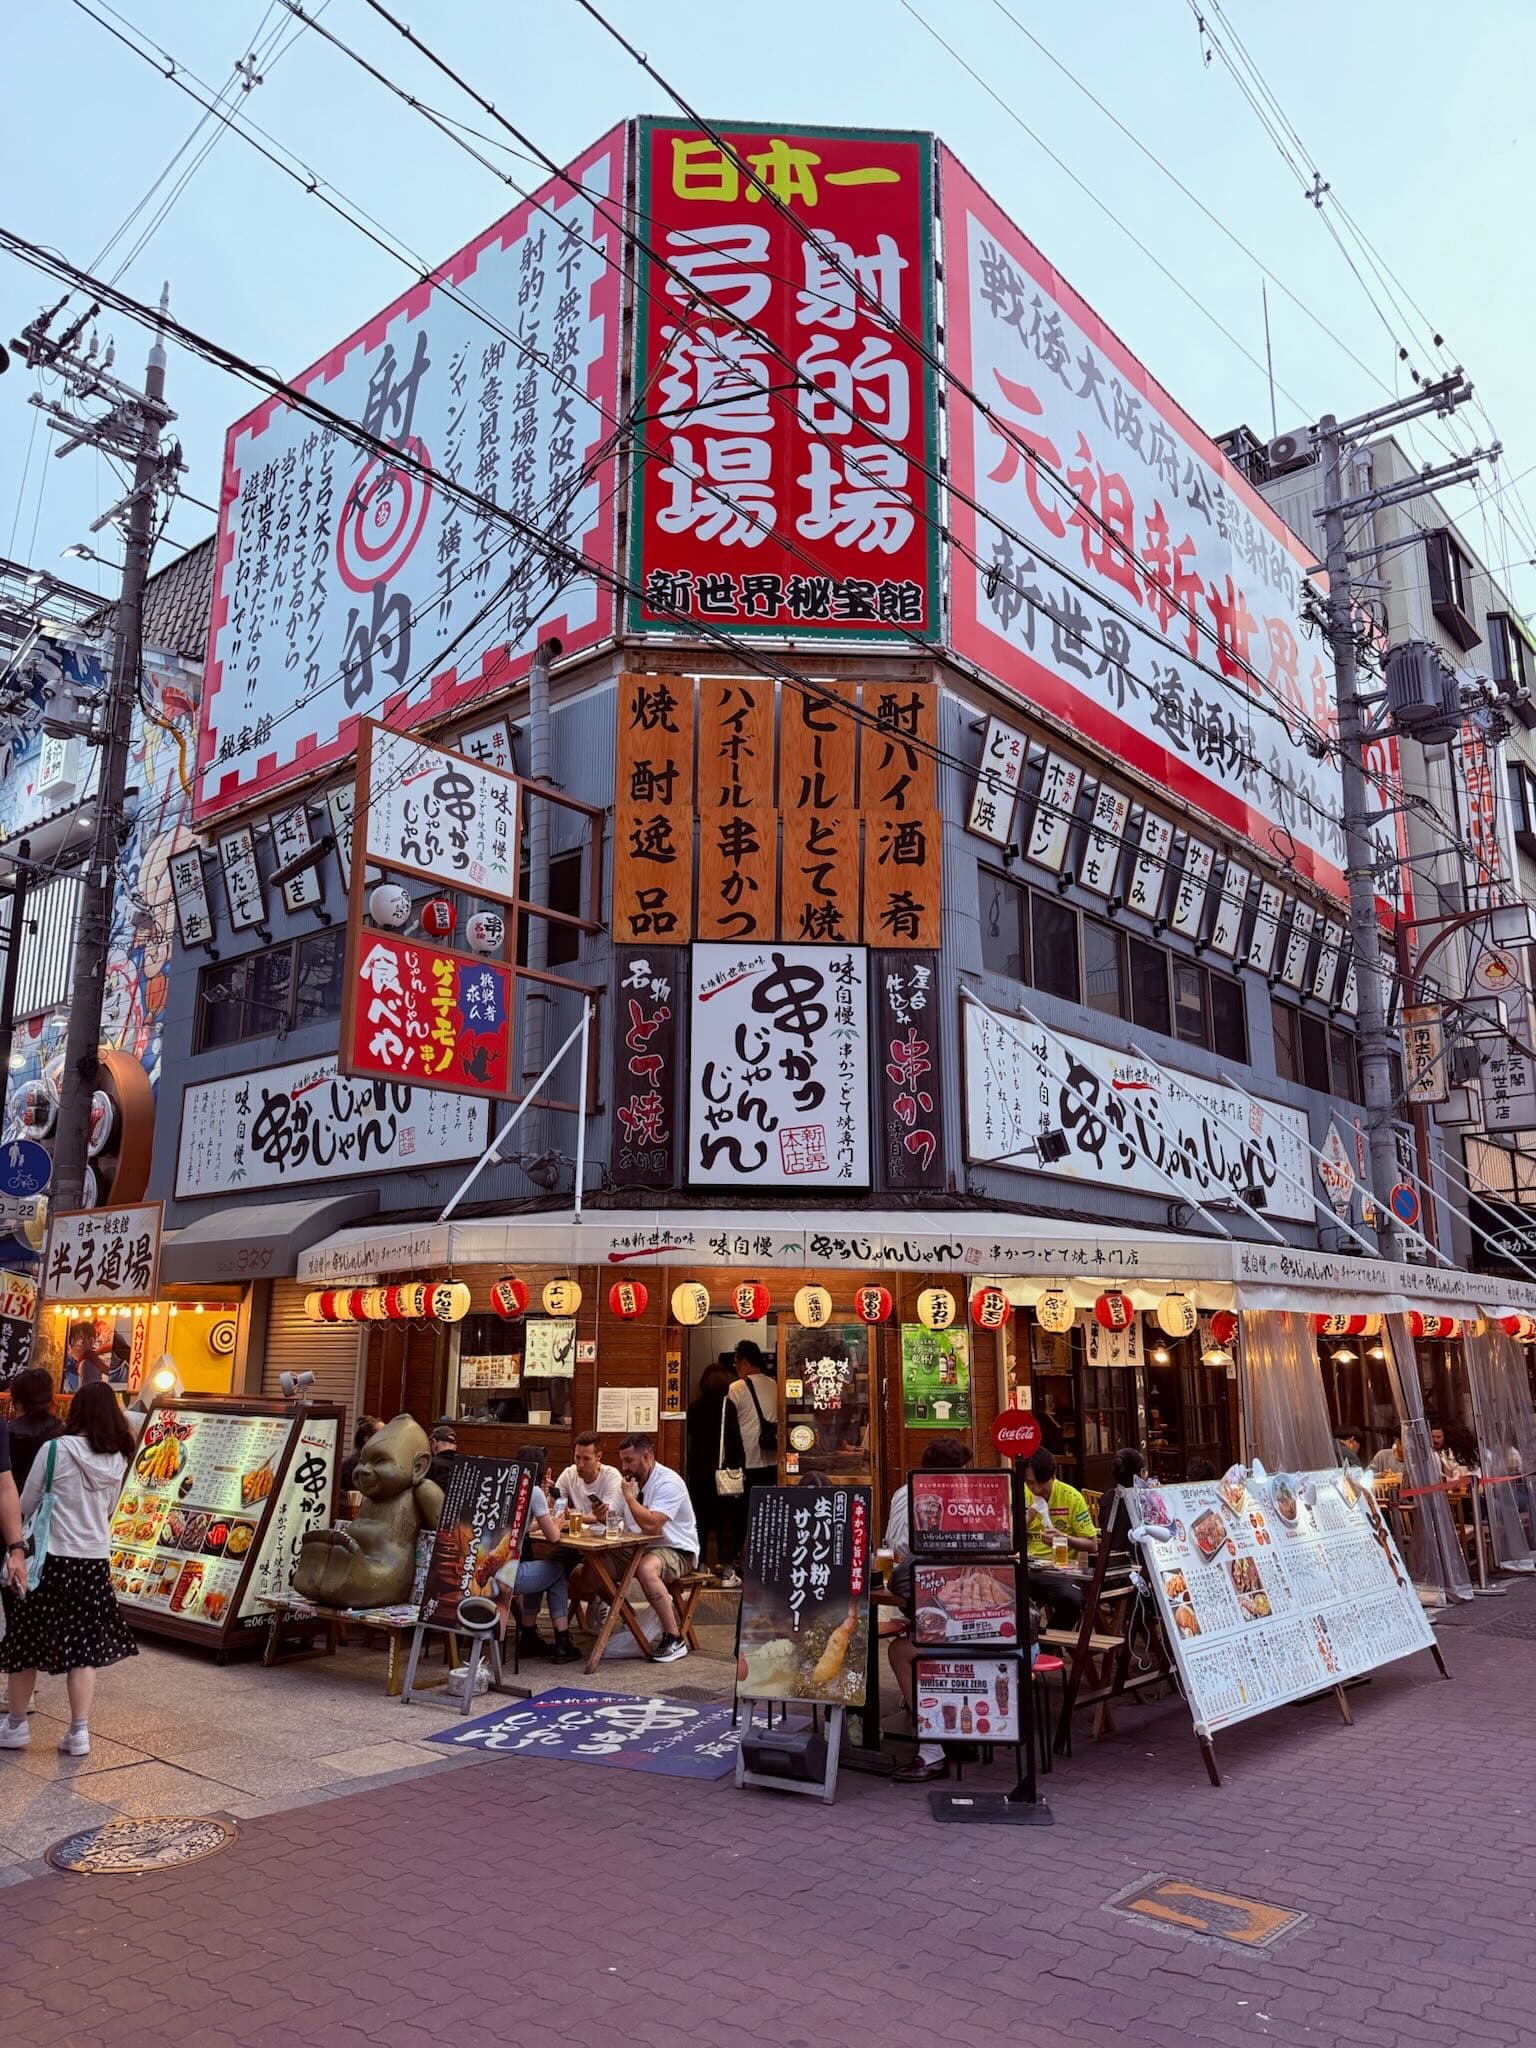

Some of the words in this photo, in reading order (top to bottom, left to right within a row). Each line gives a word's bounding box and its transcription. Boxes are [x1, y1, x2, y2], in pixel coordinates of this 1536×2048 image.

[671, 138, 901, 206] 日本一
[655, 224, 778, 549] 弓道場
[796, 232, 917, 555] 射的場
[645, 569, 924, 624] 新世界秘宝館
[629, 684, 680, 807] 焼酎
[716, 687, 754, 809] ハイボール
[801, 688, 846, 810] ビール
[876, 693, 925, 811] 酎ハイ
[990, 533, 1139, 711] 新世界
[1269, 742, 1400, 905] 射的秘館
[176, 862, 201, 940] 海老
[629, 816, 678, 938] 逸品
[717, 815, 759, 940] 串かつ
[800, 817, 846, 941] どて焼
[878, 820, 926, 941] 酒肴
[431, 958, 457, 1073] ゲテモノ
[620, 958, 673, 1003] 名物
[751, 952, 829, 1113] 串かつ
[828, 953, 863, 1028] 味自慢
[907, 965, 933, 1011] 屋台
[233, 1081, 252, 1167] 味自慢
[616, 997, 673, 1147] どて焼
[700, 1060, 768, 1174] じゃん
[734, 1022, 780, 1133] じゃん
[885, 1027, 937, 1173] 串かつ
[1490, 1059, 1511, 1120] 新世界店
[49, 1233, 153, 1294] 半弓道場
[77, 1215, 131, 1238] 日本一秘宝館
[609, 1231, 697, 1249] 本場新世界の味
[709, 1233, 773, 1259] 味自慢
[988, 1245, 1141, 1267] 串かつ・どて焼専門店
[549, 1286, 565, 1311] エビ
[809, 1495, 833, 1601] 生パン粉で
[947, 1503, 995, 1516] OSAKA
[789, 1507, 812, 1632] サックサク!
[920, 1663, 951, 1673] WHISKY
[954, 1663, 975, 1673] COKE
[920, 1679, 948, 1689] WHISKY
[951, 1679, 969, 1689] COKE
[970, 1679, 988, 1689] ZERO
